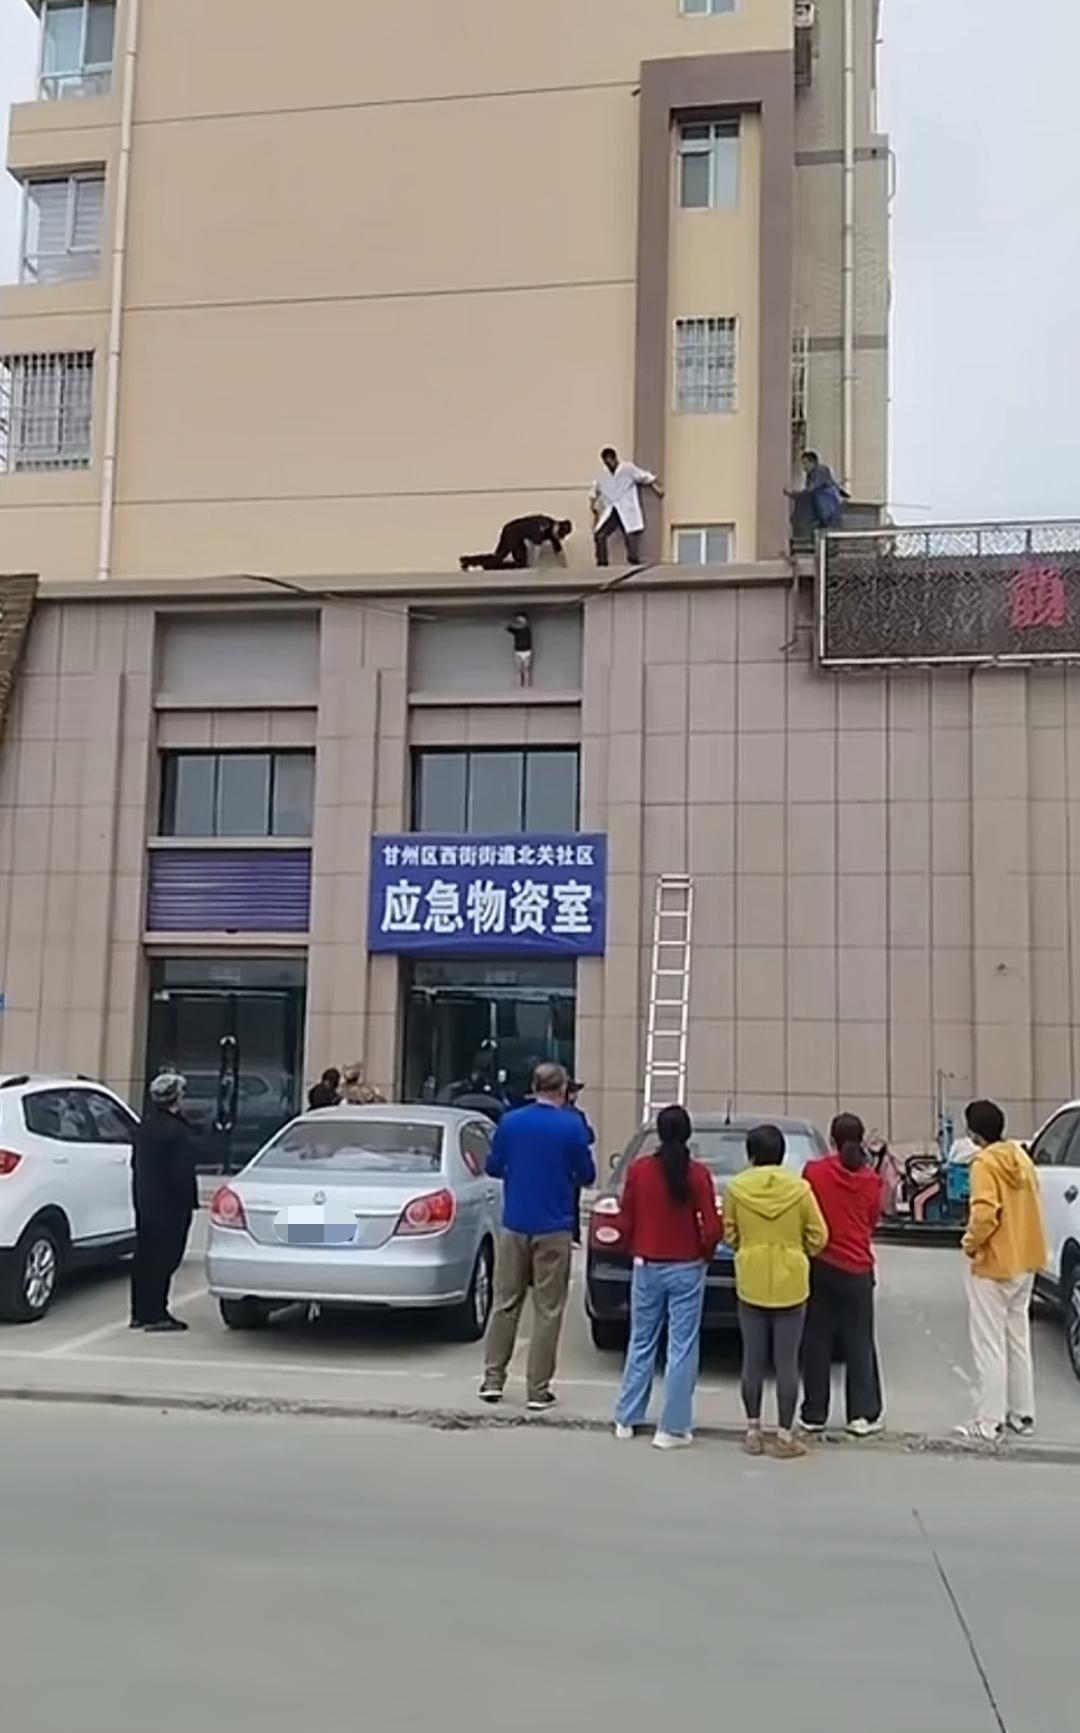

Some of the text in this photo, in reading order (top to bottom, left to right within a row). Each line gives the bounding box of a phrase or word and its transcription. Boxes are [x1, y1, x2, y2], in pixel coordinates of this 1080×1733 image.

[383, 844, 594, 866] 甘州区西街街道北关社区
[381, 878, 593, 934] 应急物资室
